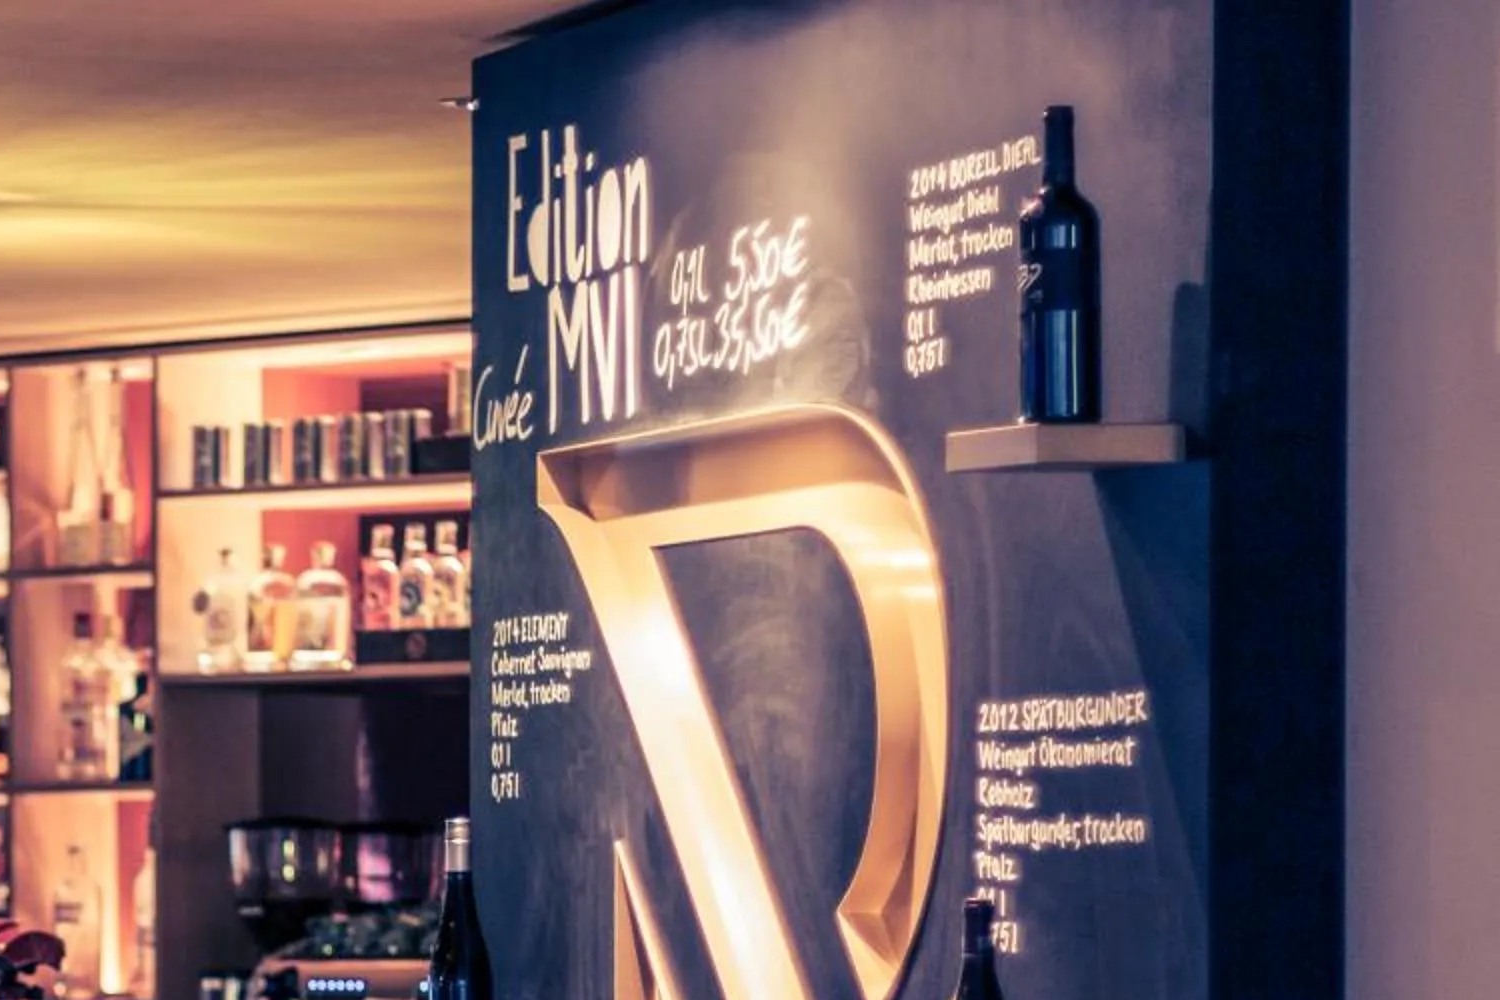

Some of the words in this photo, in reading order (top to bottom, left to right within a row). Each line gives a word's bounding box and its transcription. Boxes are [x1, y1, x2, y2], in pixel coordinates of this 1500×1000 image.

[910, 161, 948, 199] 2014
[507, 124, 648, 291] Edition
[910, 196, 966, 234] Weingut
[961, 223, 1013, 259] trocken
[908, 268, 992, 304] Rheinhessen
[473, 344, 533, 451] Cuvée
[549, 264, 637, 436] MVI
[492, 616, 519, 648] 2014
[521, 611, 569, 643] ELEMENT
[492, 649, 536, 677] Cabernet
[538, 645, 591, 679] Sauvignon
[530, 677, 571, 705] trocken
[490, 710, 519, 738] Pfalz
[978, 702, 1019, 733] 2012
[1022, 690, 1148, 732] SPÄTBURGUNDER
[978, 739, 1036, 777] Weingut
[978, 776, 1036, 810] Rebholz
[1083, 811, 1146, 845] trocken
[973, 850, 1019, 881] Pfalz
